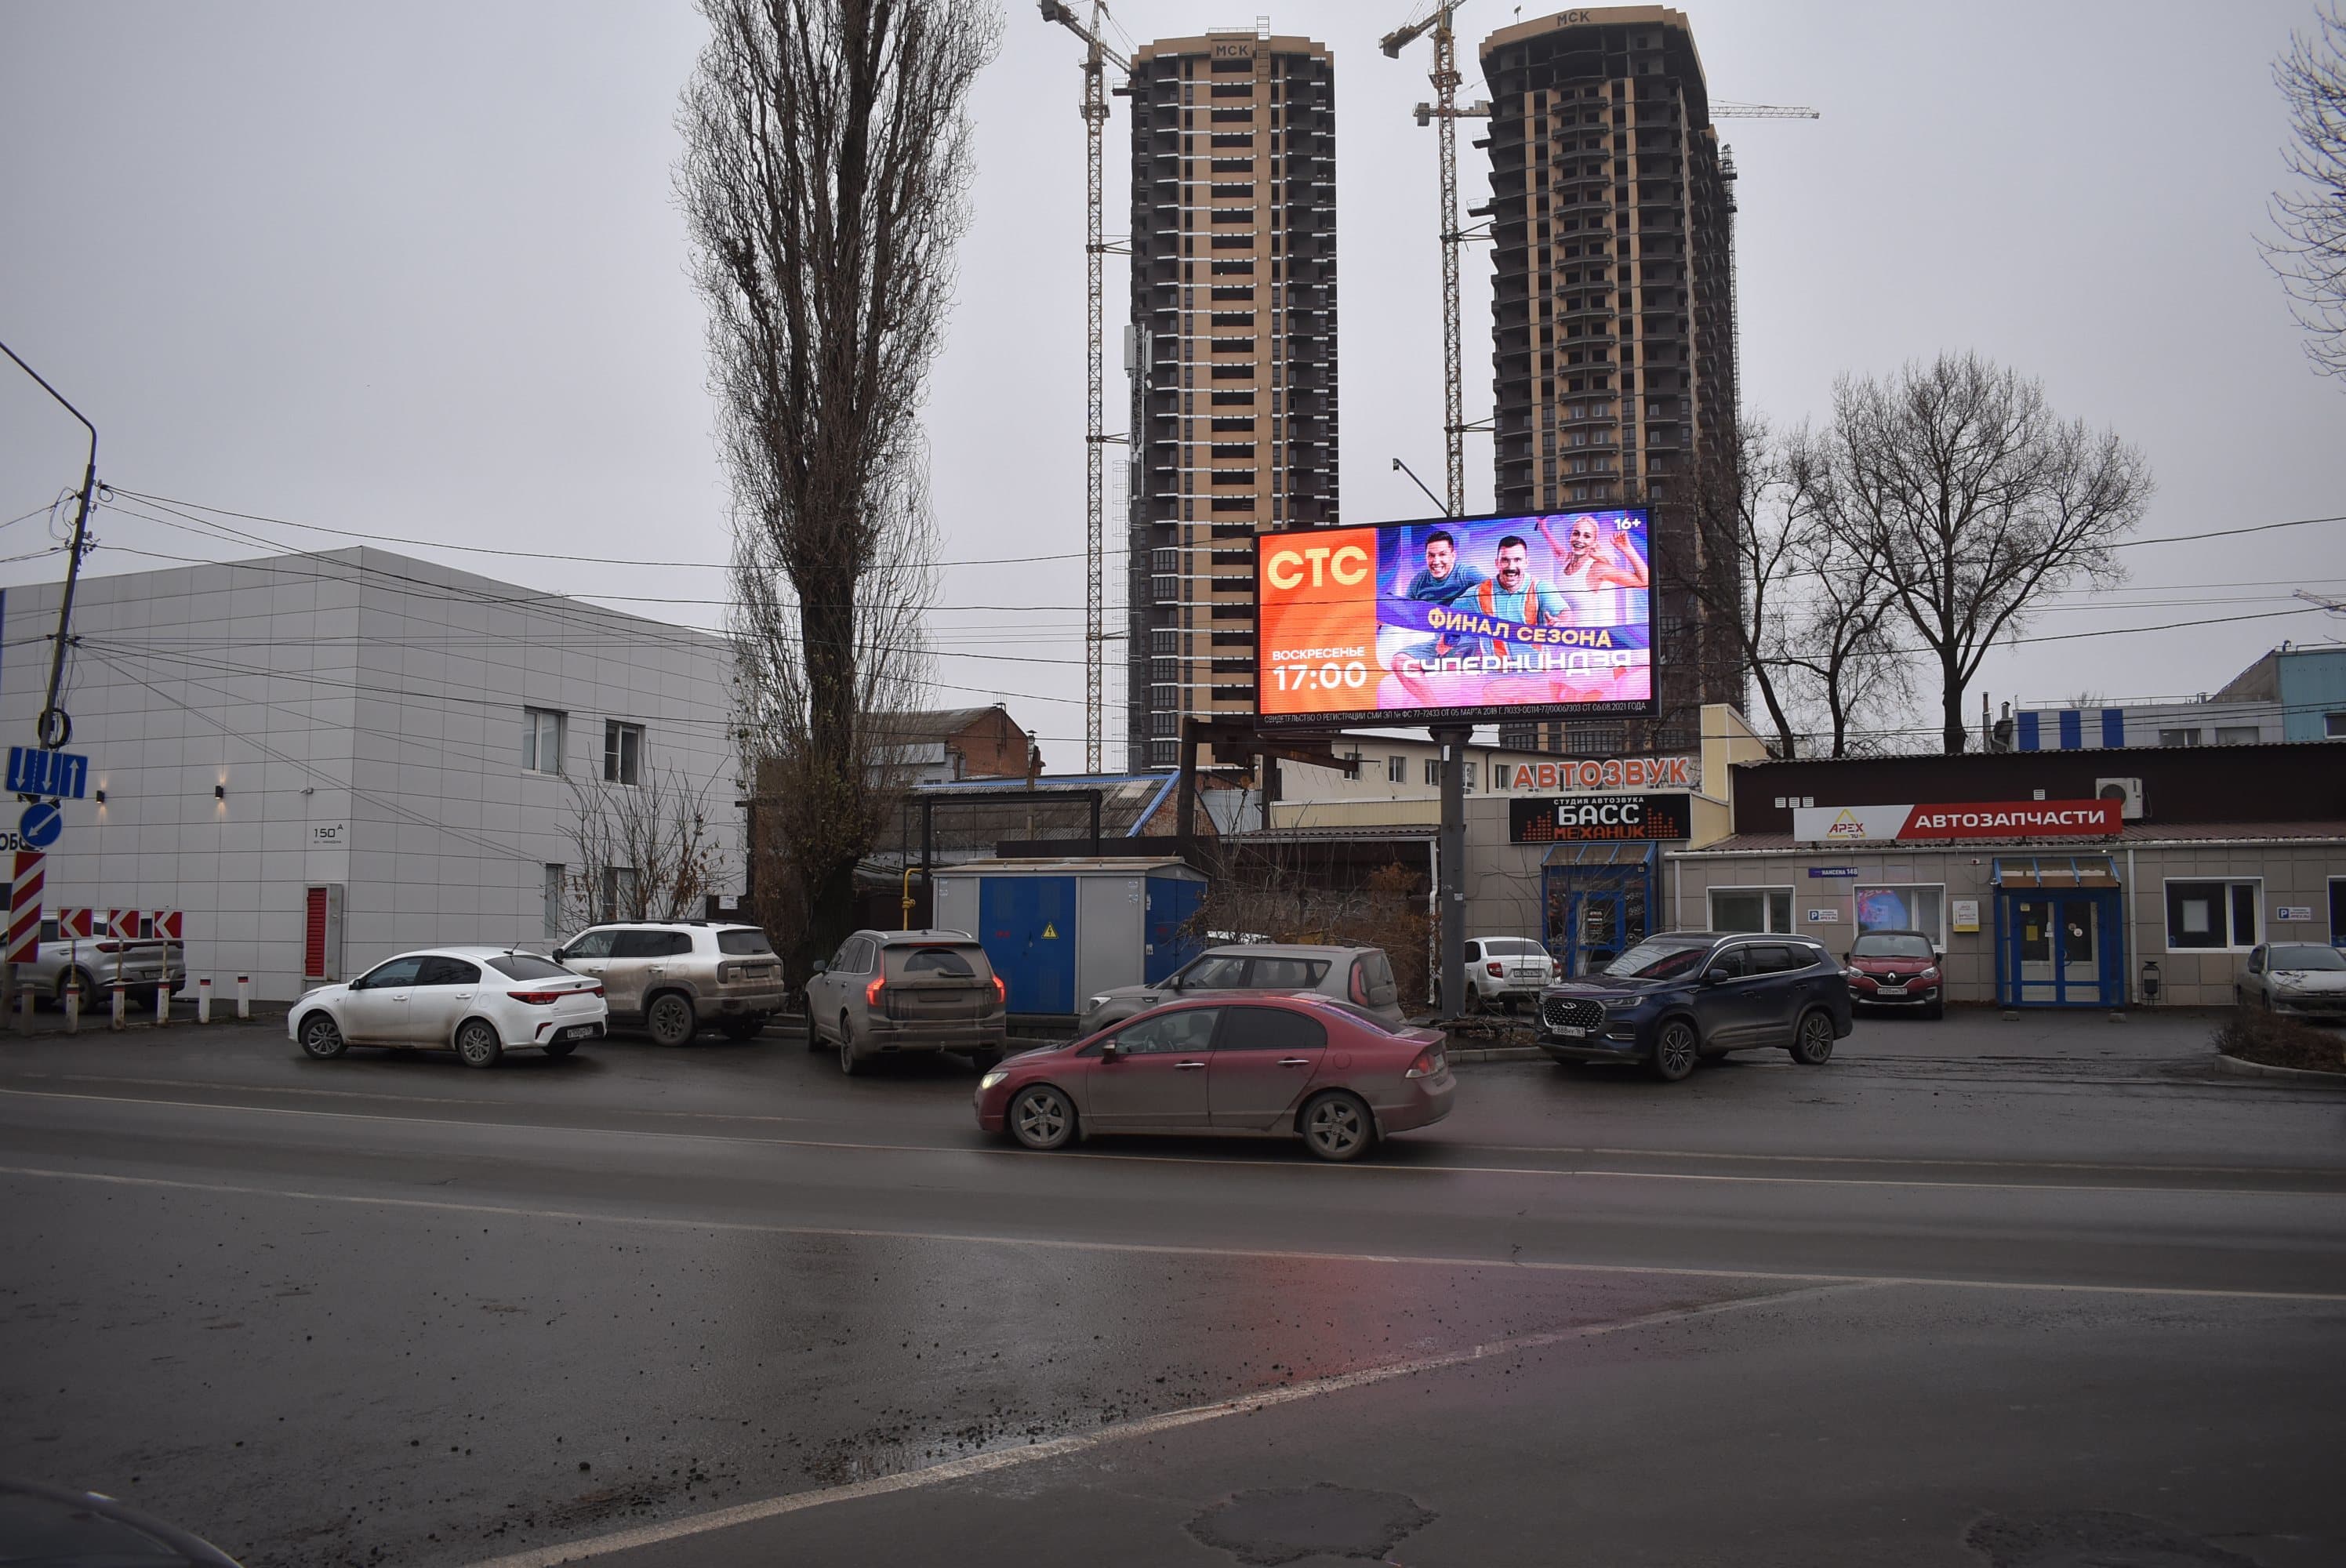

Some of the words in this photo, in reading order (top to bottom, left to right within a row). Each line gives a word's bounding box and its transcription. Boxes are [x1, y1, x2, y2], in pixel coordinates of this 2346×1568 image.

[1557, 11, 1590, 27] МСК
[1216, 45, 1249, 56] МСК
[1614, 518, 1641, 530] 16+
[1267, 546, 1368, 590] СТС
[1428, 607, 1509, 638] ФИНАЛ
[1516, 626, 1613, 648] СЕЗОНА
[1272, 646, 1365, 661] ВОСКРЕСЕНЬЕ
[1273, 661, 1367, 691] 17:00
[1264, 713, 1316, 724] СВИДЕТЕЛЬСТВО
[1324, 711, 1365, 721] РЕГИСТРАЦИИ
[1367, 711, 1382, 720] СМИ
[1414, 710, 1440, 718] 77-72433
[1628, 702, 1647, 711] ГОДА
[1513, 758, 1689, 789] АВТОЗВУК
[1558, 804, 1640, 826] БАСС
[1915, 810, 2104, 829] АВТОЗАПЧАСТИ
[1554, 825, 1645, 840] МЕХАНИК
[1828, 822, 1864, 833] APEX
